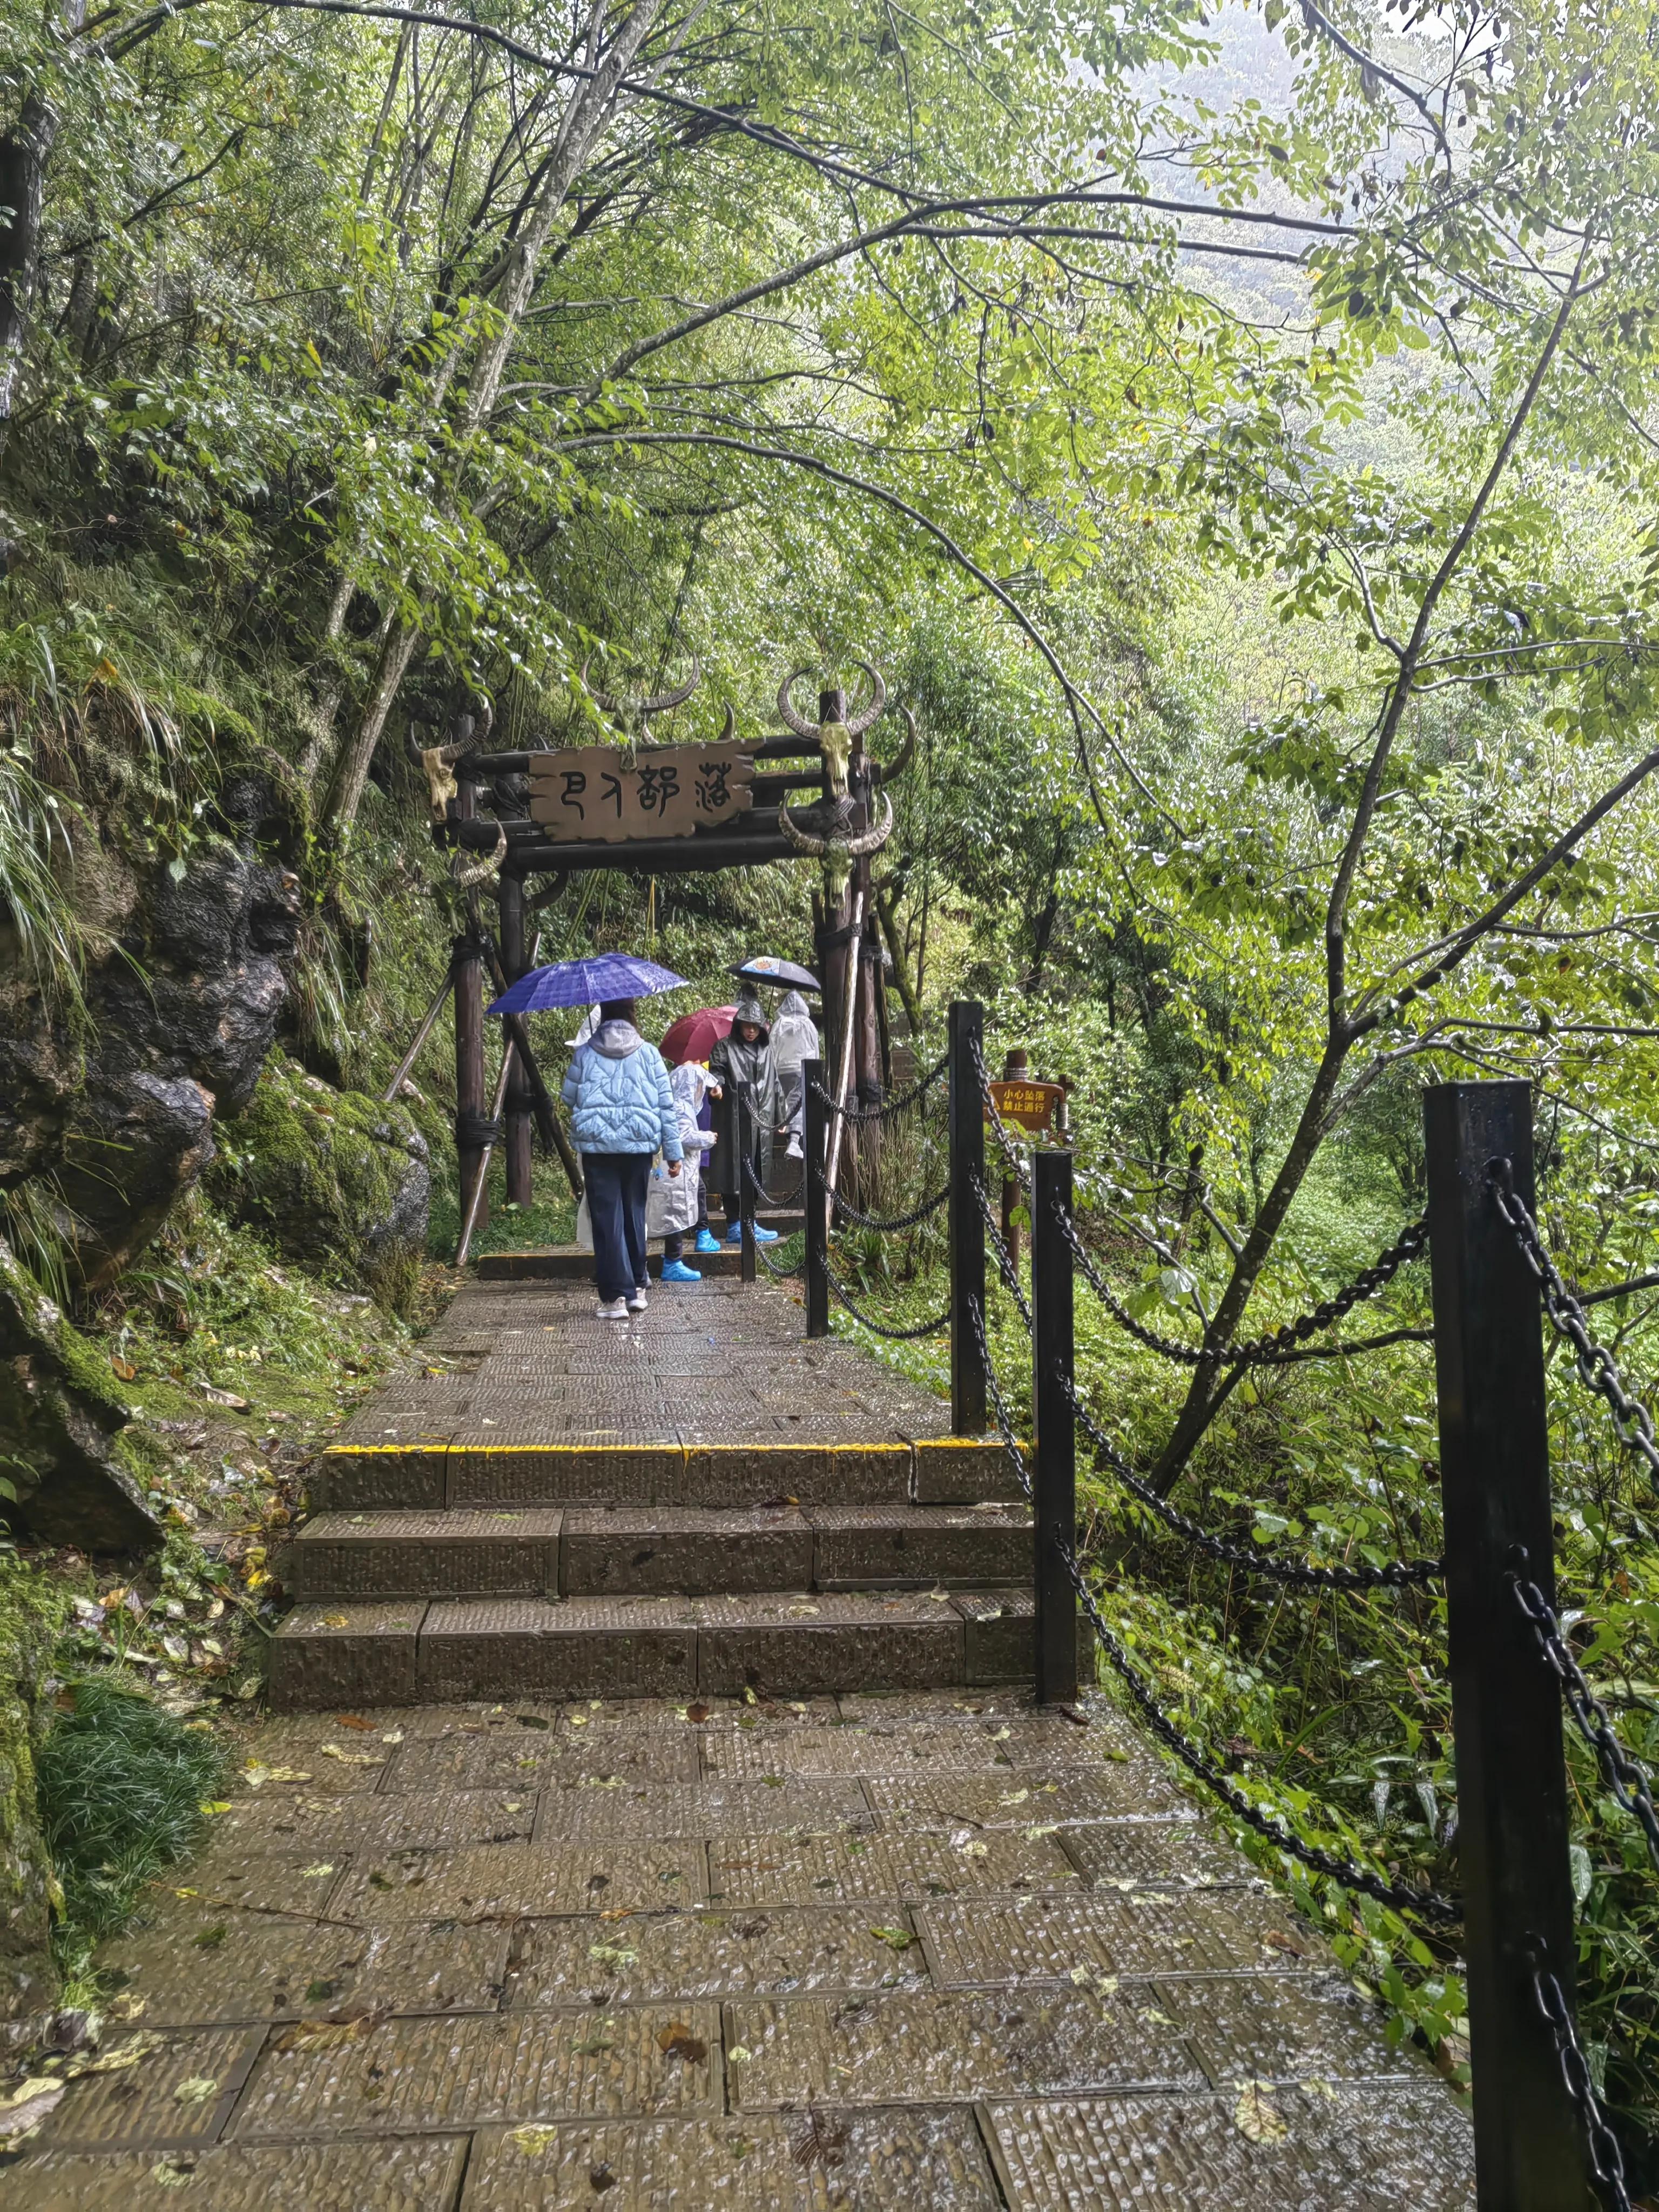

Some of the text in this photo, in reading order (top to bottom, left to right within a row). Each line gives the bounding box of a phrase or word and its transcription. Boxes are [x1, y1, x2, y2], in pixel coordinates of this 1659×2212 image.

[1003, 1089, 1046, 1101] 小心坠落
[1003, 1101, 1045, 1112] 禁止通行
